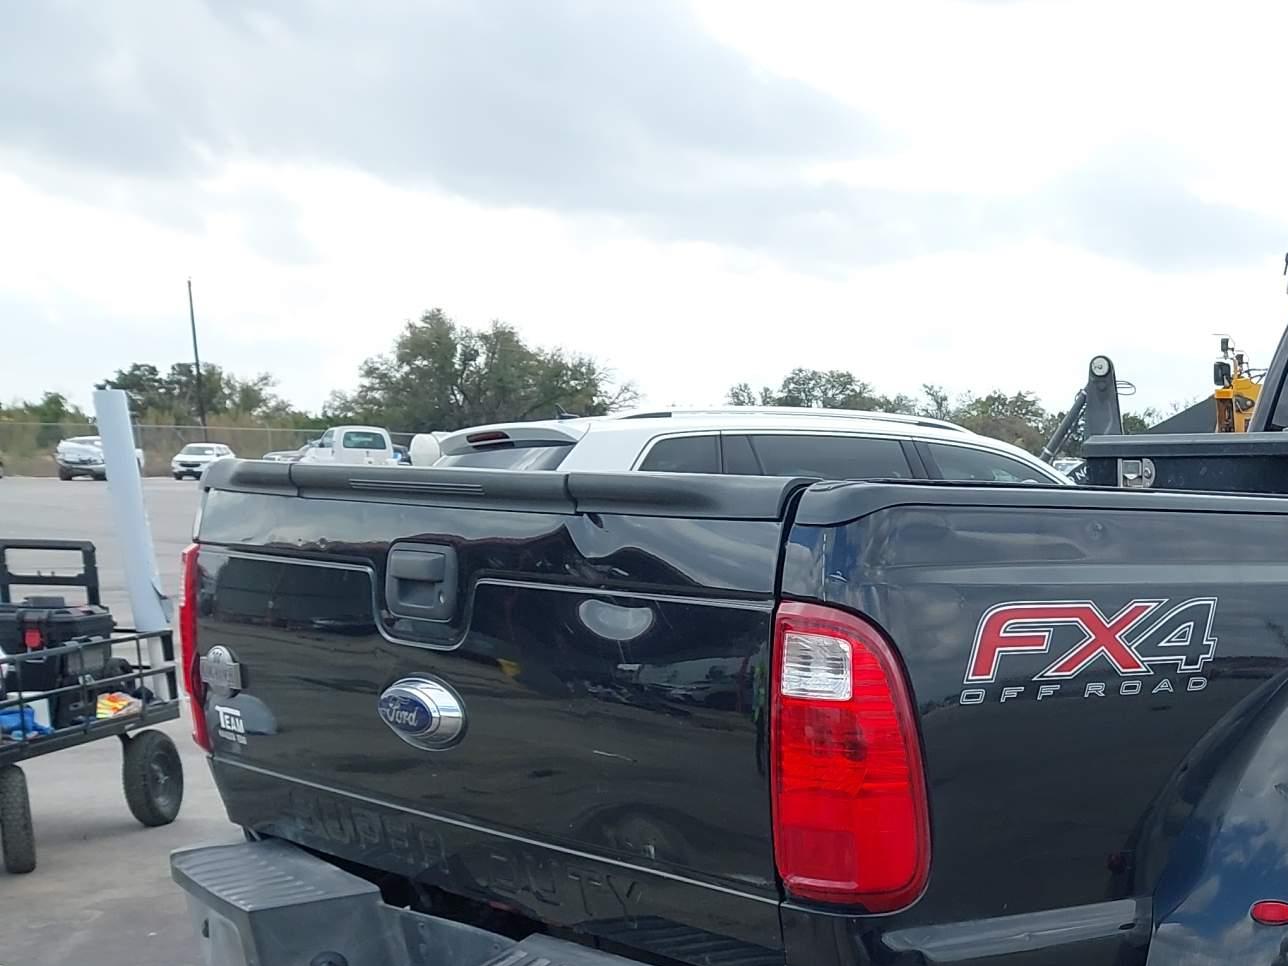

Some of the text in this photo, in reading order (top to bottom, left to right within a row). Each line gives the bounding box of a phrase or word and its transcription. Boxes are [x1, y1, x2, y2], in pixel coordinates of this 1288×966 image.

[963, 597, 1218, 684] FX4
[959, 677, 1208, 705] OFF ROAD
[214, 704, 246, 733] TEAM
[378, 698, 418, 727] Ford
